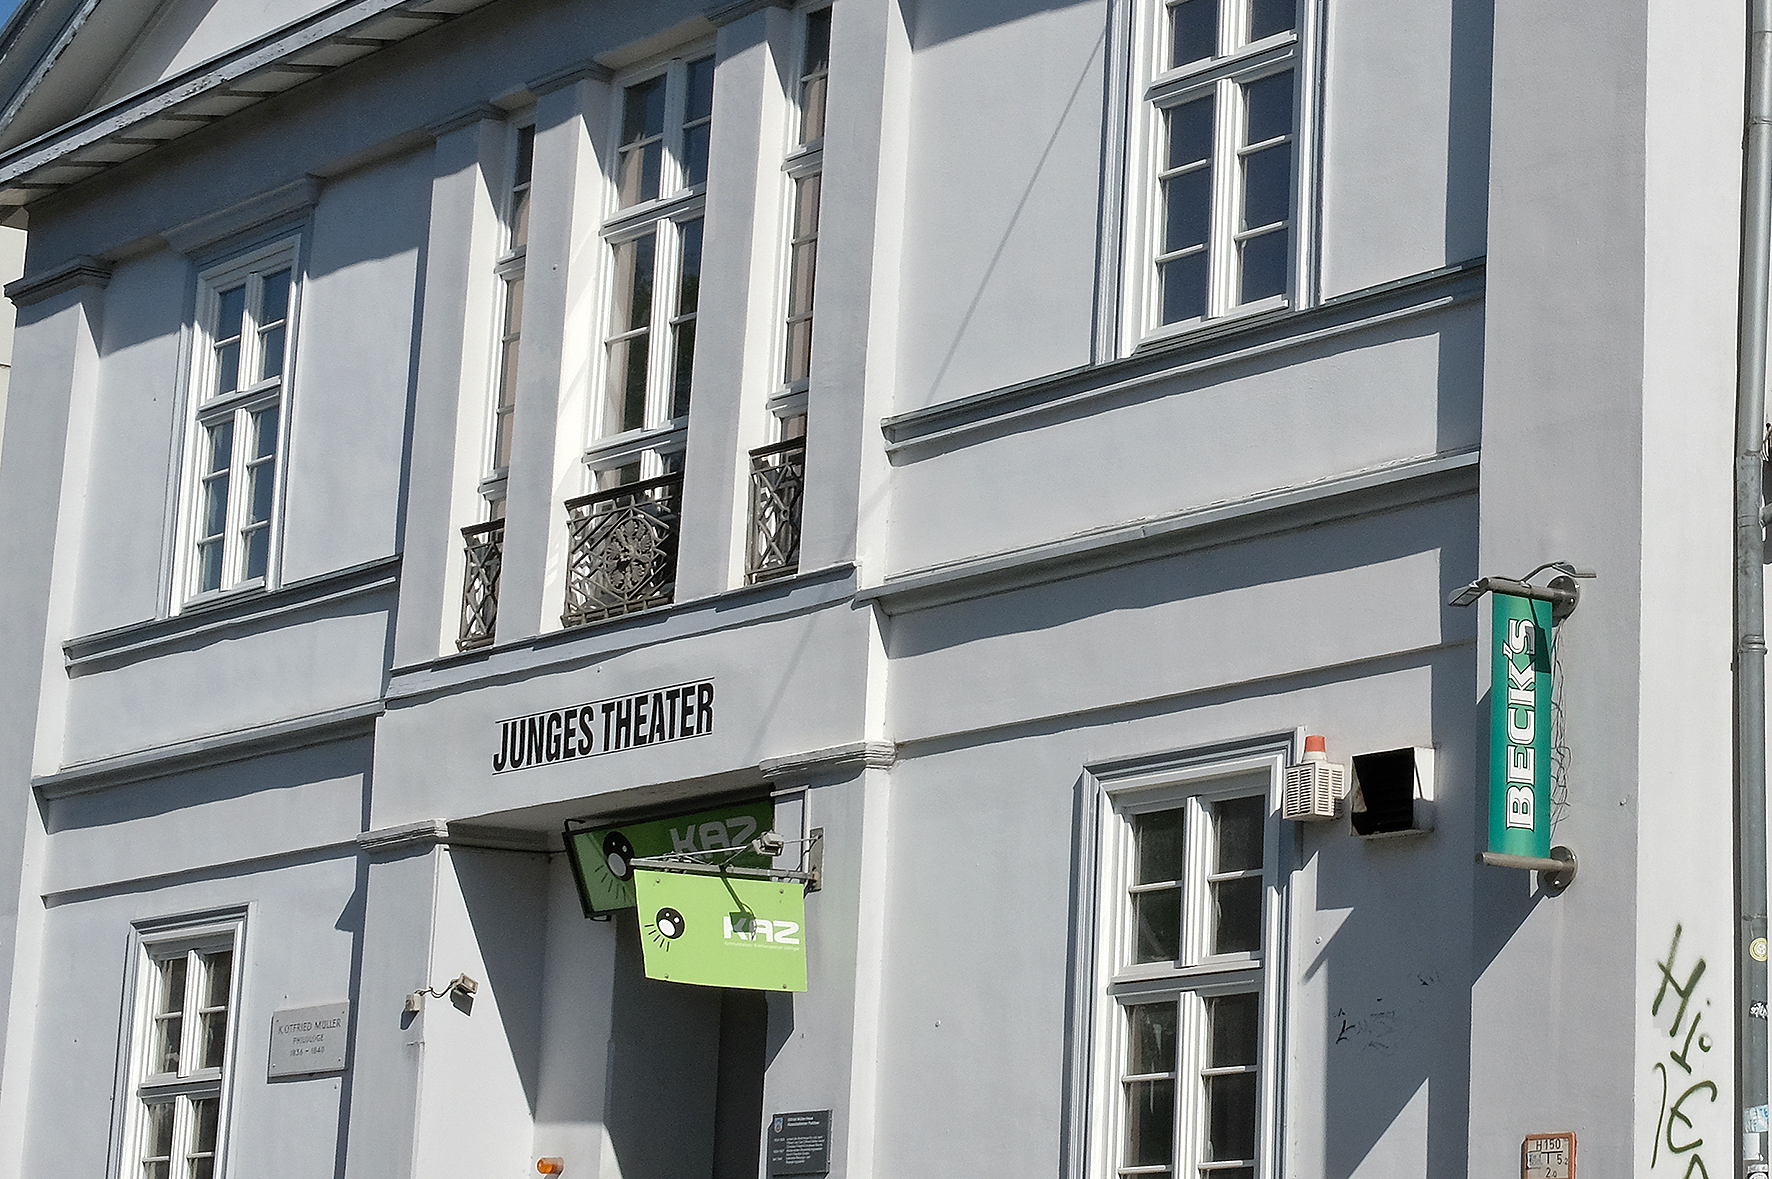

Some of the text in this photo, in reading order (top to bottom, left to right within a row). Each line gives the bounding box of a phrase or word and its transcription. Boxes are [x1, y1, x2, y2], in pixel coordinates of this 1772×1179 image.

[492, 682, 714, 772] JUNGES THEATER
[1503, 619, 1536, 832] BECK'S
[669, 815, 758, 860] KAZ
[723, 916, 800, 945] KAZ
